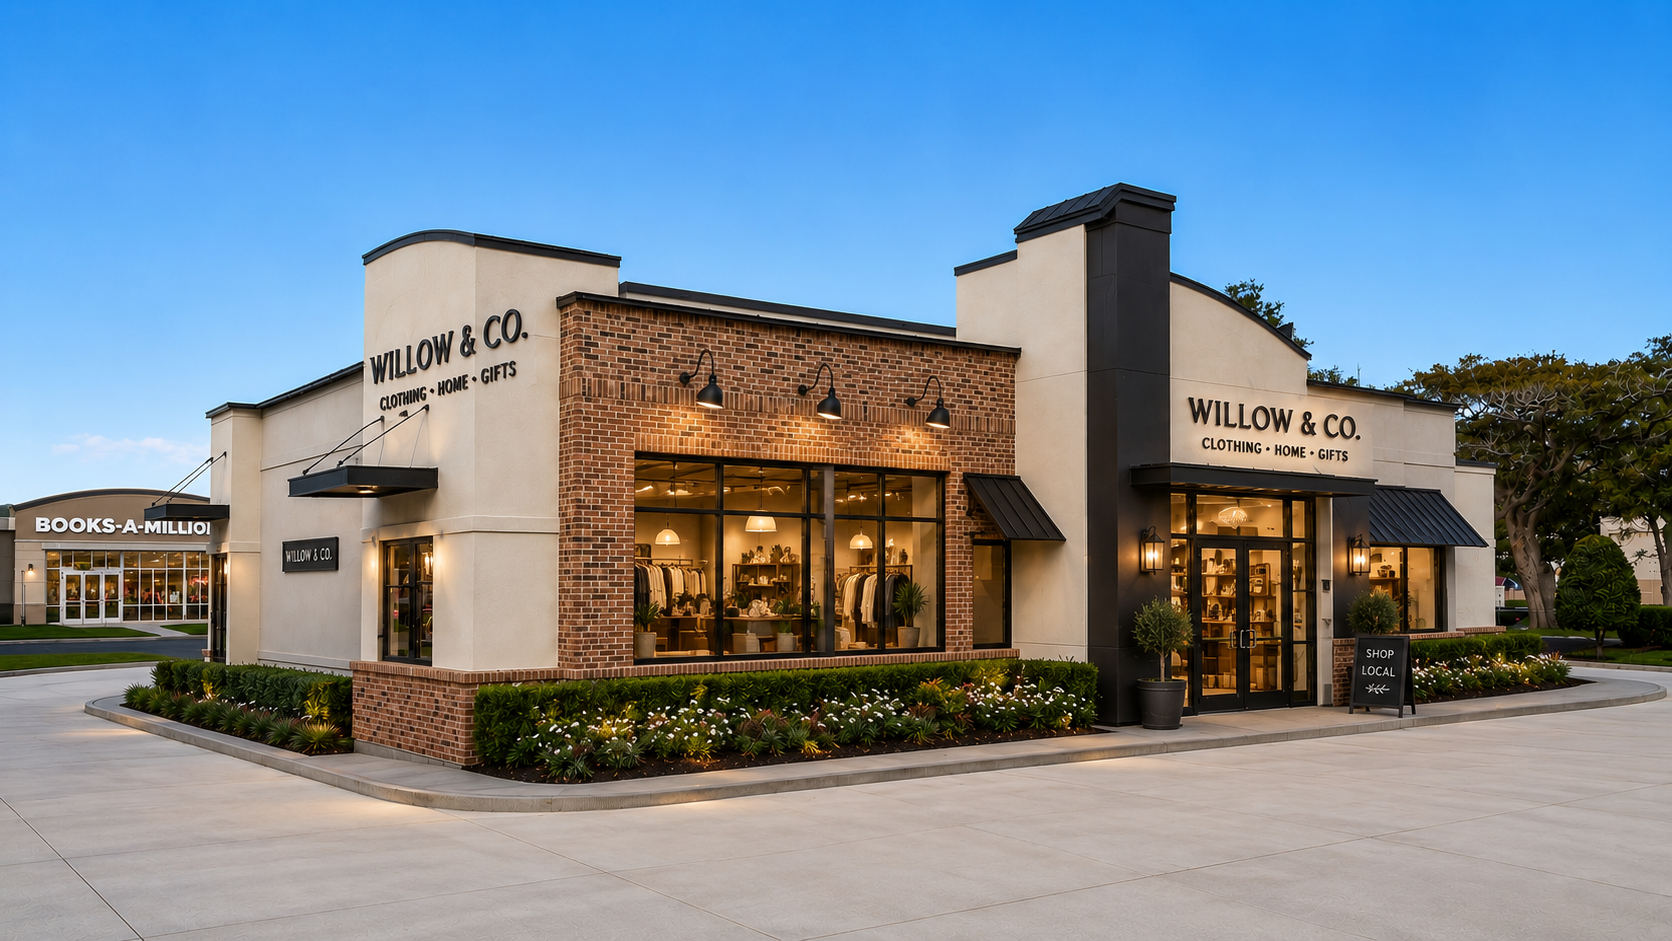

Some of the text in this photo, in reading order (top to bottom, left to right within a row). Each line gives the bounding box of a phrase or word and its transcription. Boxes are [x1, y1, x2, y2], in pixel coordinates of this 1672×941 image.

[369, 308, 528, 384] WILLOW & CO.
[379, 360, 517, 411] CLOTHING HOME GIFTS
[1188, 396, 1361, 440] WILLOW & CO.
[1201, 437, 1349, 462] CLOTHING HOME GIFTS
[35, 516, 210, 535] BOOKS-A-MILLIO
[285, 549, 312, 563] WILLOW
[1366, 648, 1395, 659] SHOP
[1361, 665, 1396, 677] LOCAL
